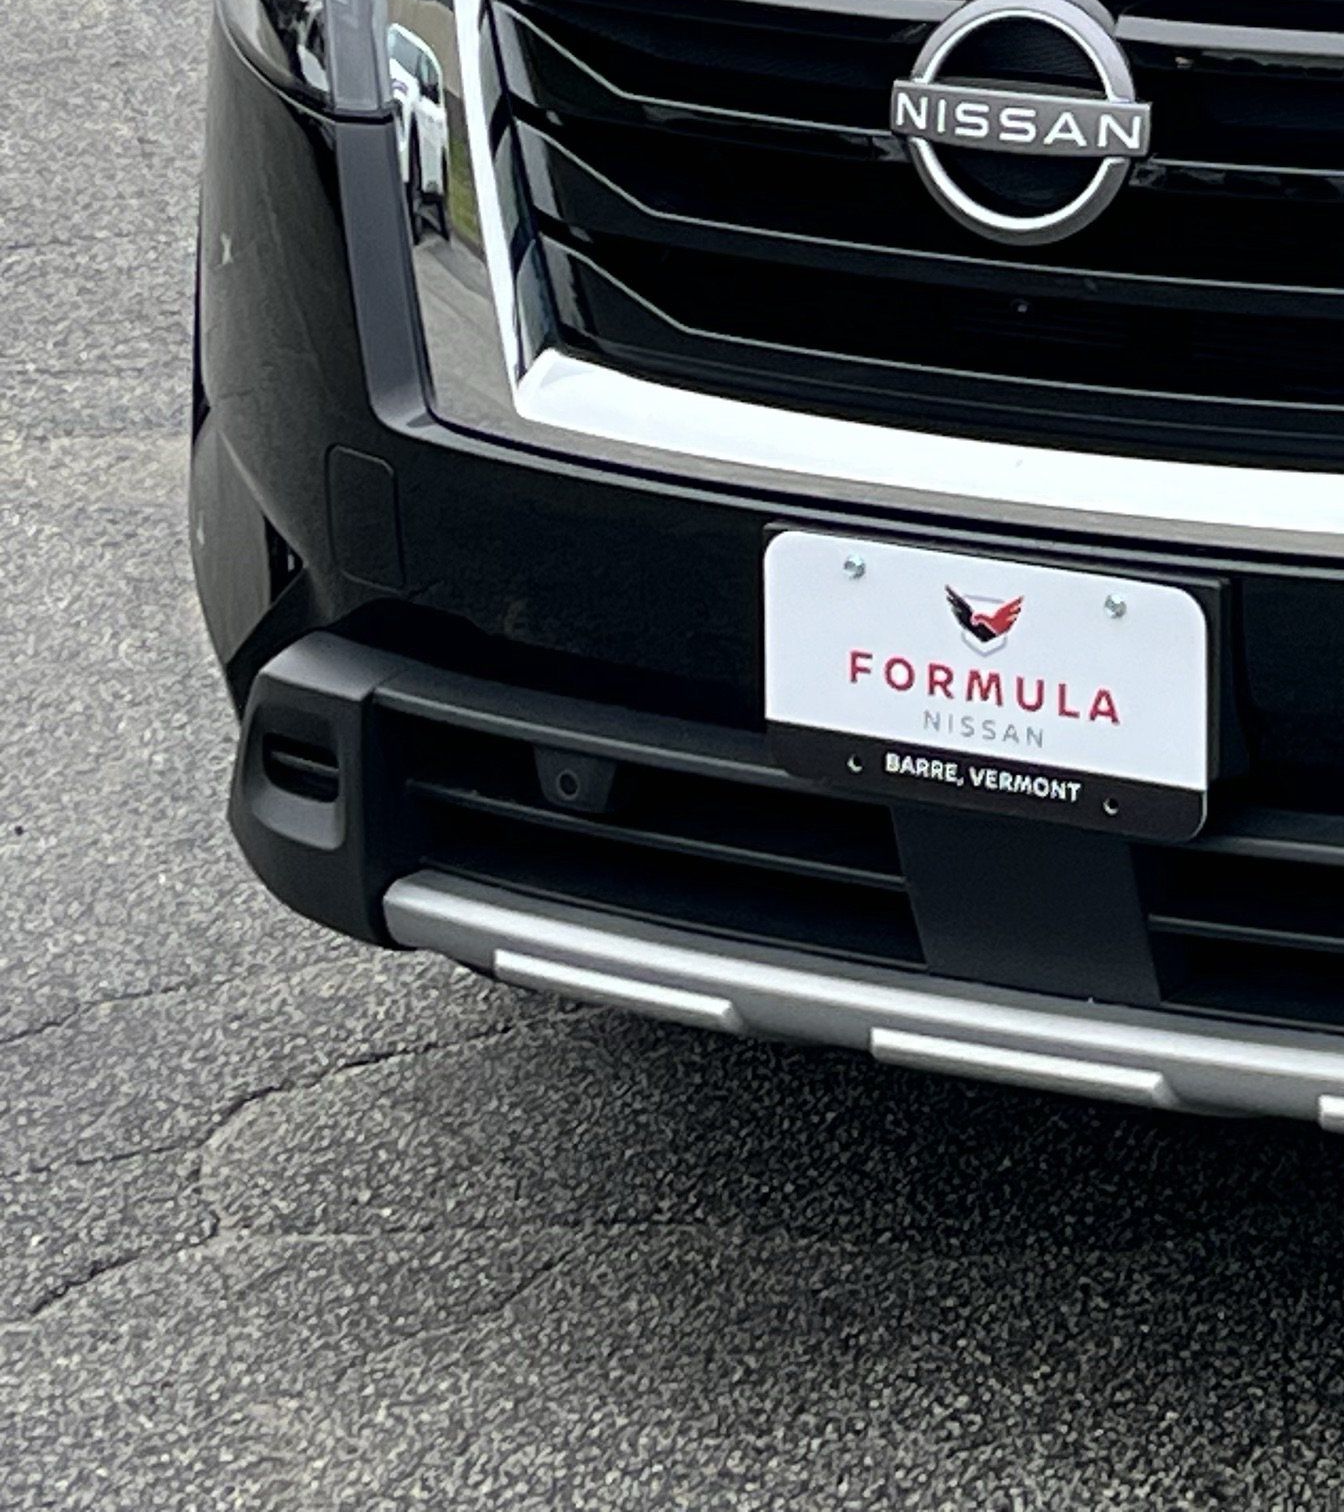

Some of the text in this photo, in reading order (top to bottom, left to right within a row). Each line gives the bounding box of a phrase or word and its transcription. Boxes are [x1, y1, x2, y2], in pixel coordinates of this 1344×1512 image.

[895, 92, 1142, 149] NISSAN
[849, 650, 1120, 725] FORMULA
[923, 709, 1044, 749] NISSAN
[885, 752, 1082, 803] BARRE, VERMONT
